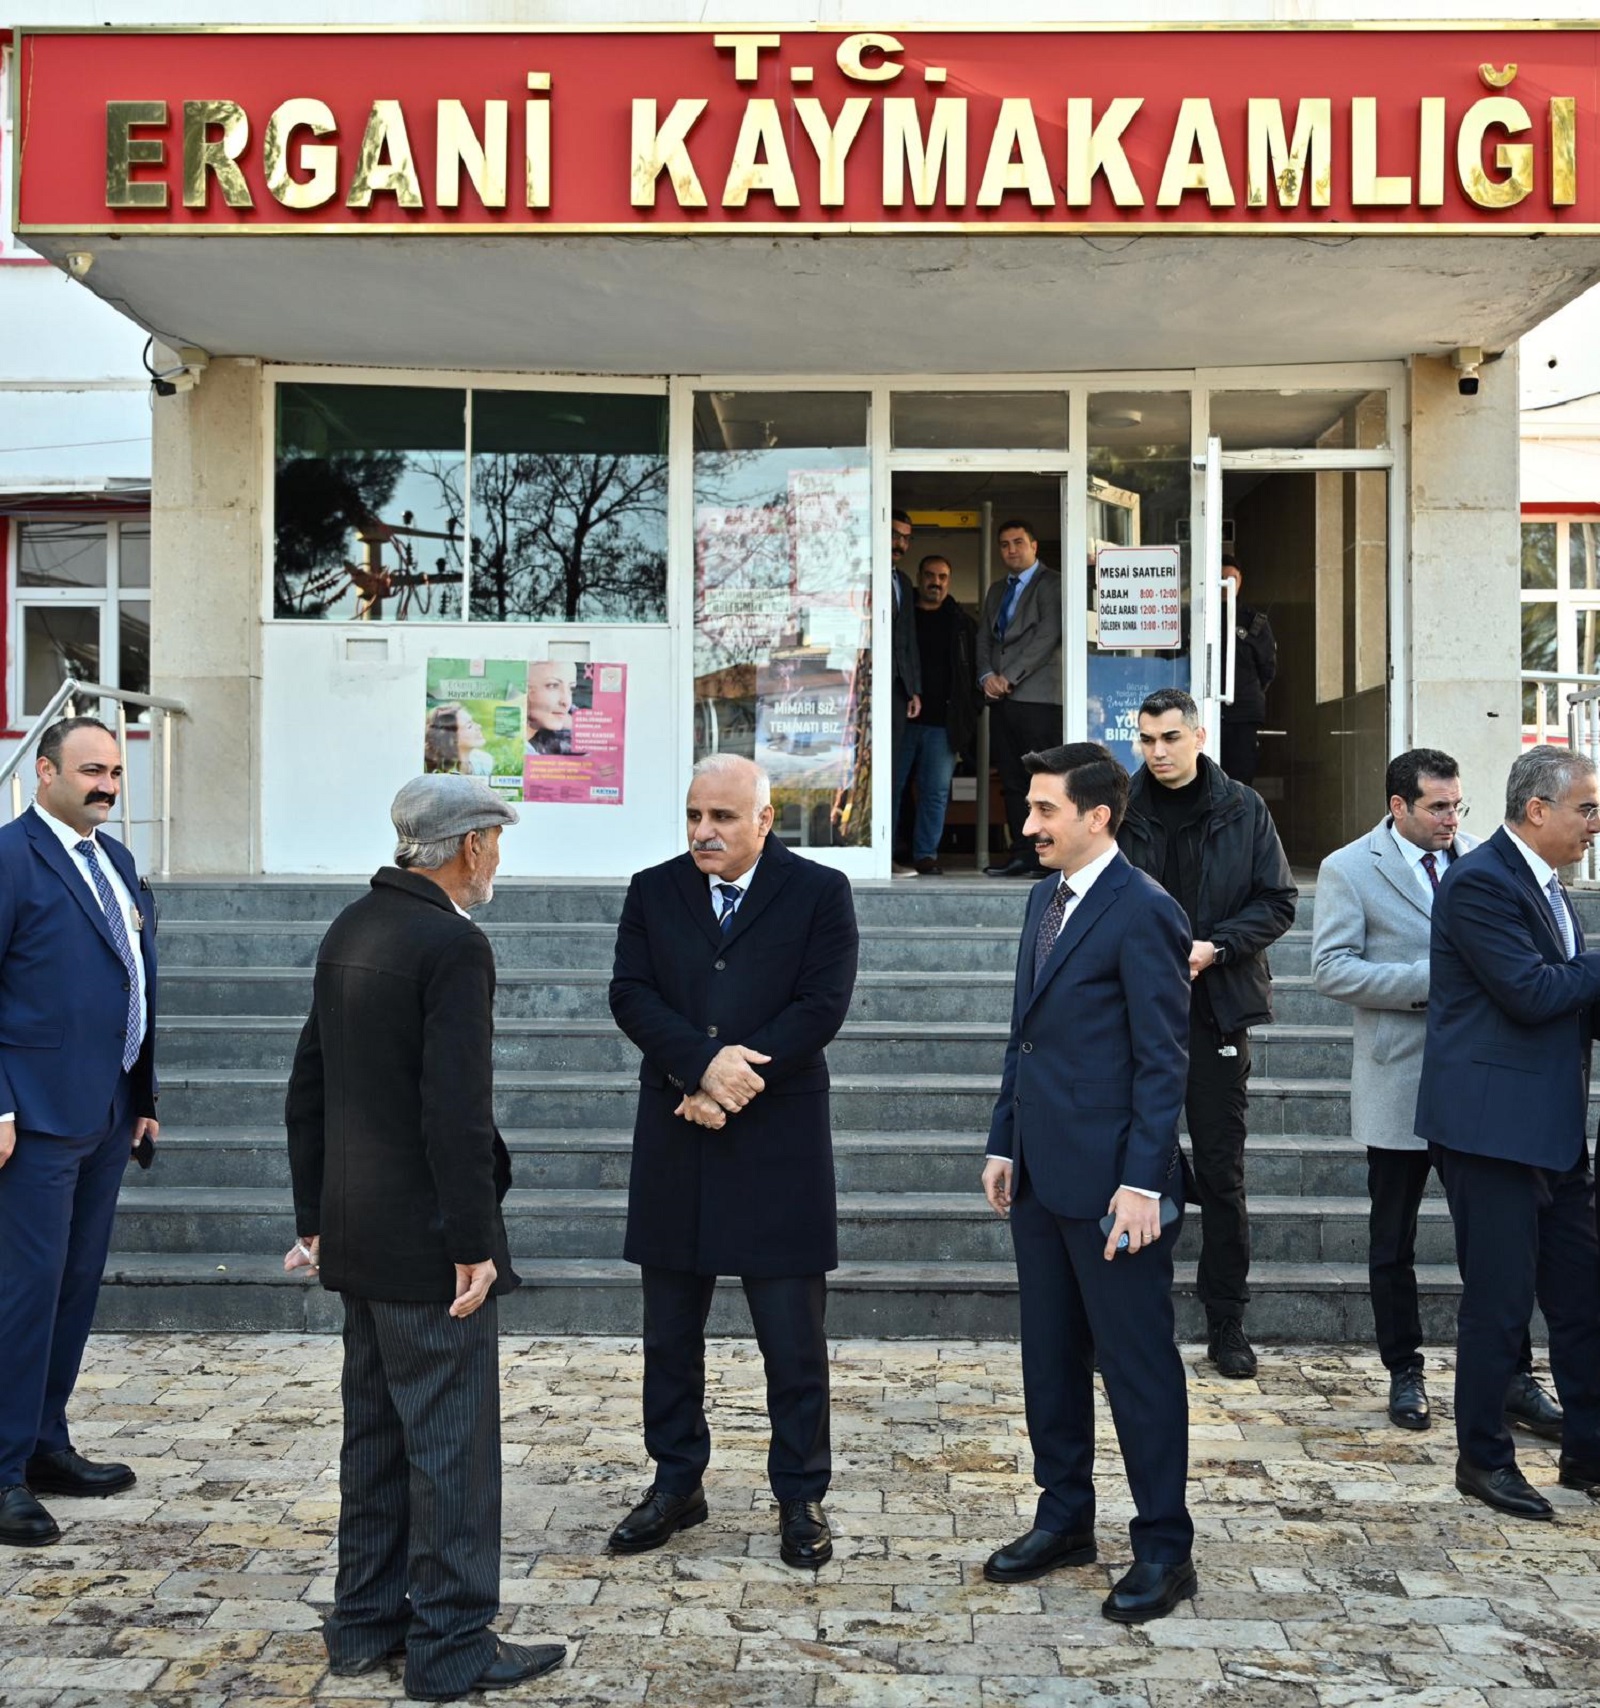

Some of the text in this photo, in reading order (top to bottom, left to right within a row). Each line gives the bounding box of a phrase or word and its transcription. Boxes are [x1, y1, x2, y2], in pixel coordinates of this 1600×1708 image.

[713, 33, 948, 83] T.C.
[105, 62, 1576, 209] ERGANİ KAYMAKAMLIĞI
[1100, 564, 1176, 578] MESAİ SAATLERİ
[1100, 589, 1129, 599] SABAH
[1159, 588, 1178, 599] 12:00
[1100, 603, 1117, 615] ÖĞLE
[1118, 605, 1138, 615] ARASI
[1140, 604, 1157, 615] 12:00
[1105, 728, 1141, 741] BIRA
